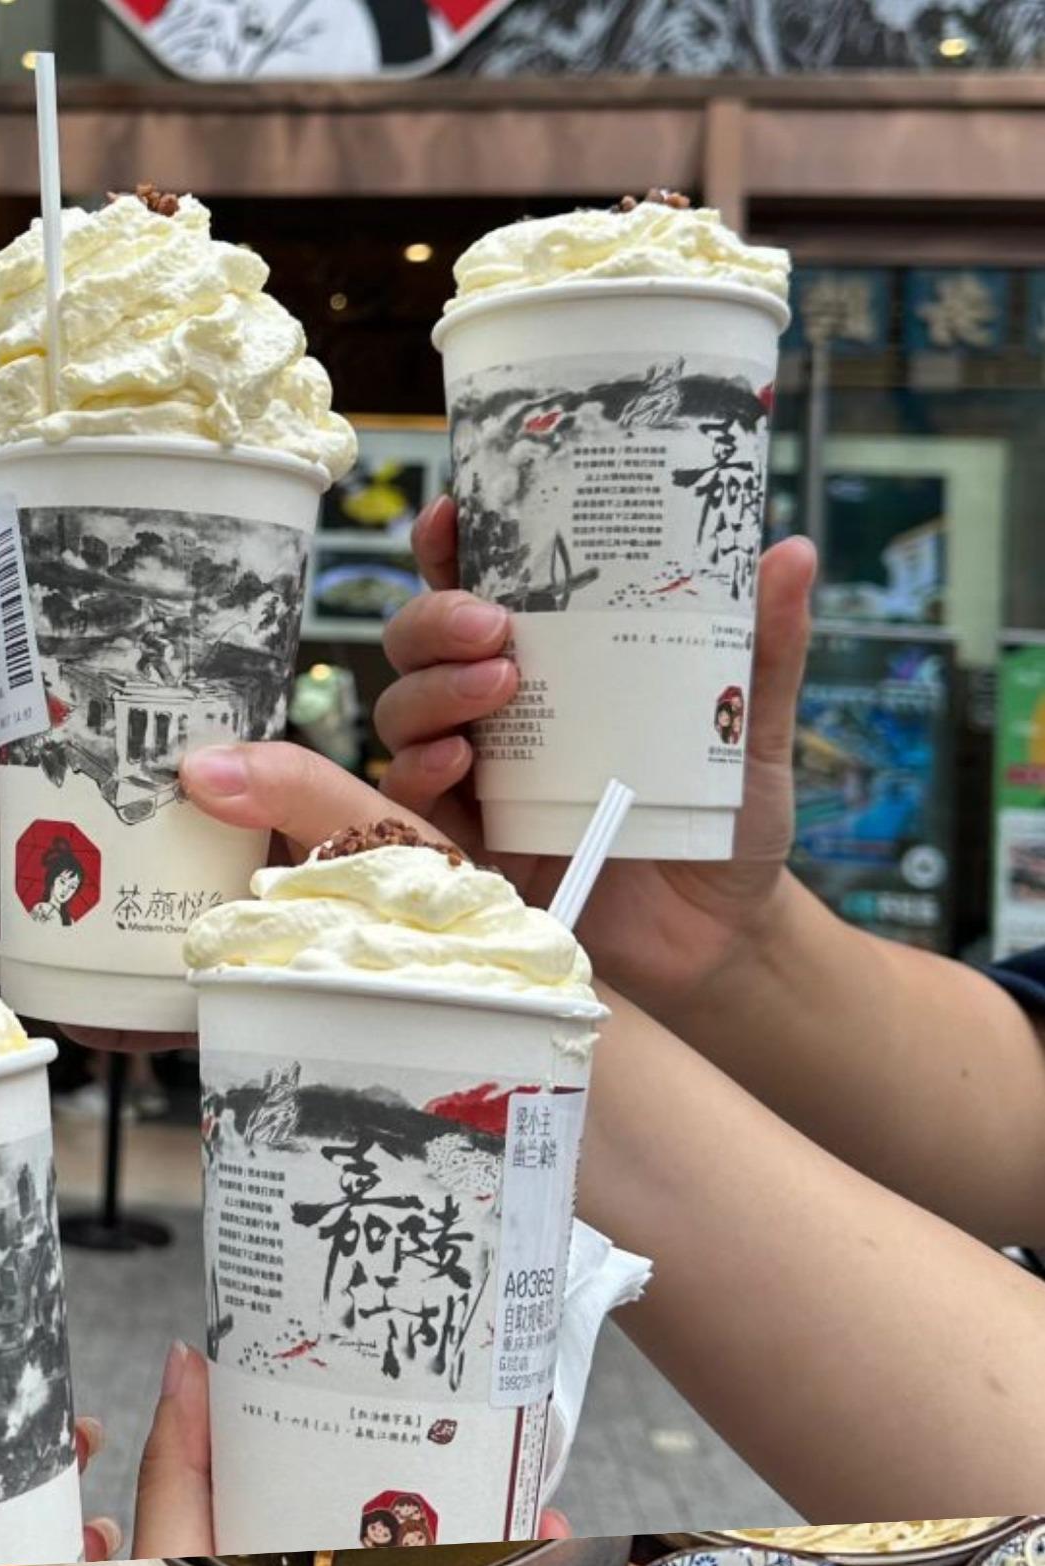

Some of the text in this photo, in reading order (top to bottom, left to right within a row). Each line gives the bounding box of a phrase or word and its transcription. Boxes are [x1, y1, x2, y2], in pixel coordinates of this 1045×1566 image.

[128, 922, 163, 933] Modern
[291, 1138, 475, 1392] 嘉陵江湖
[504, 1267, 555, 1299] A0369
